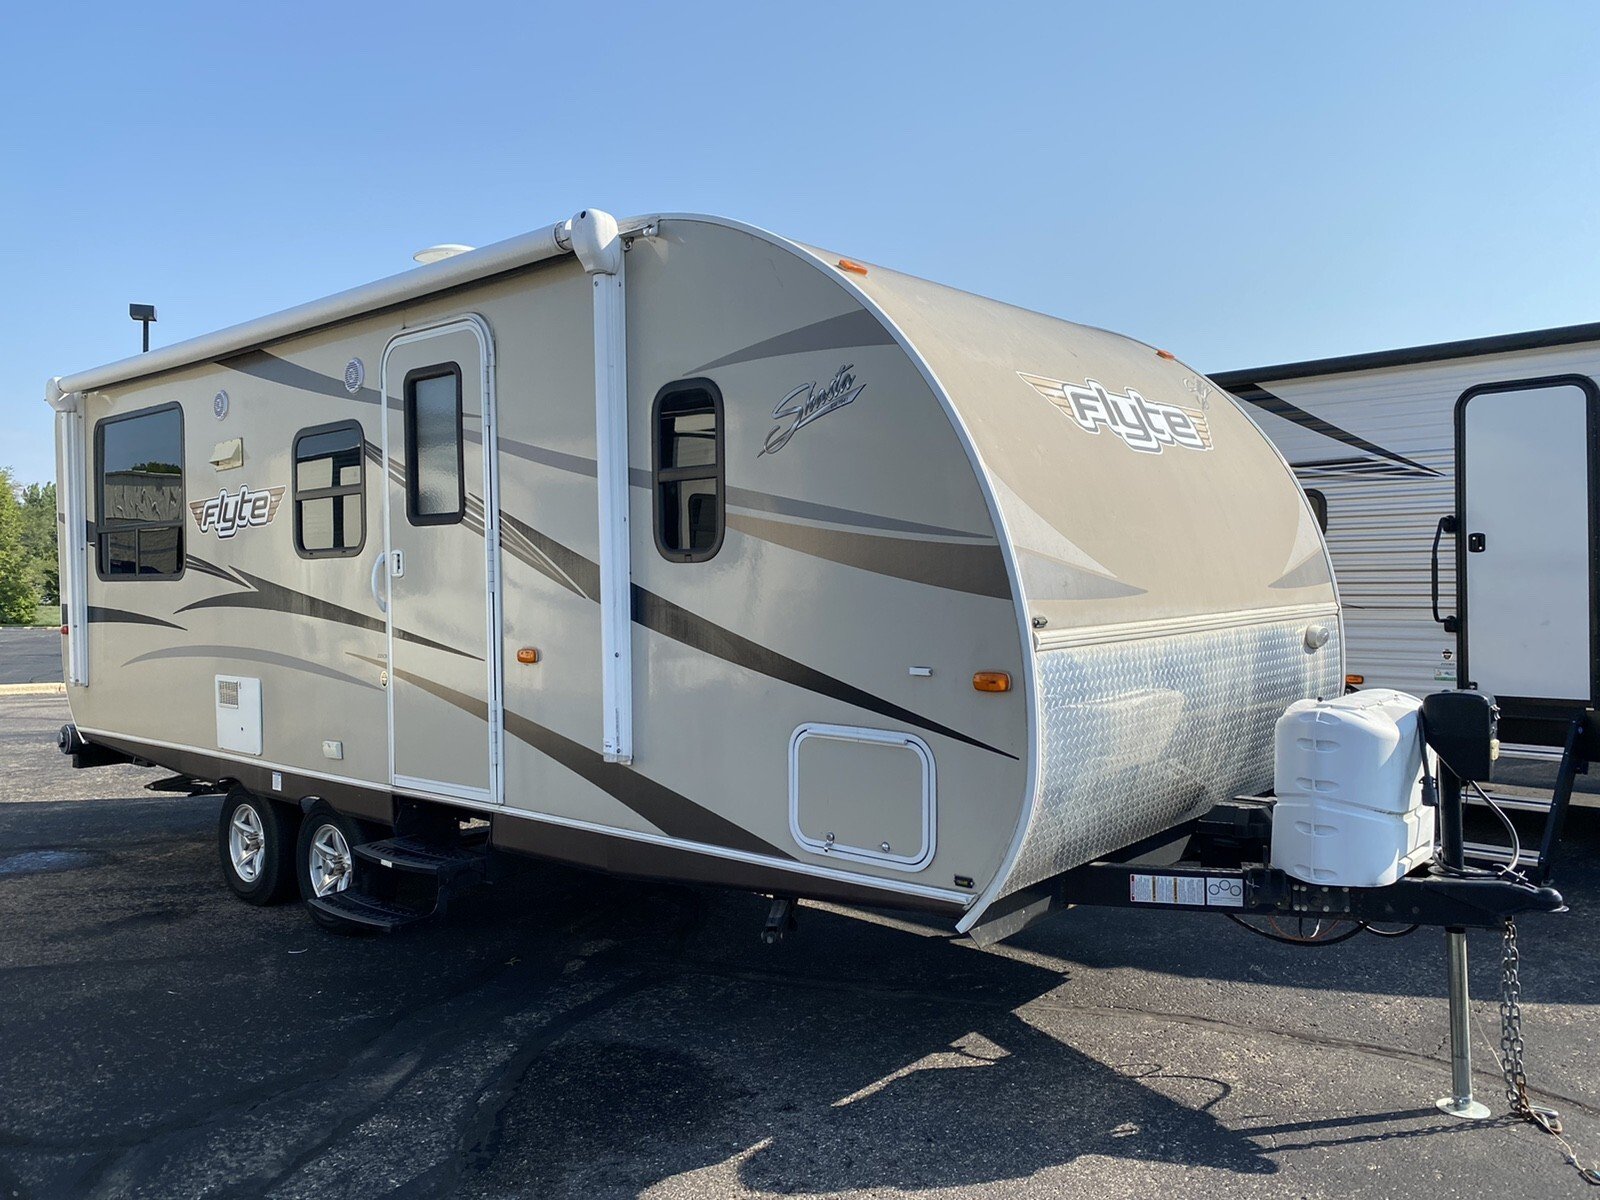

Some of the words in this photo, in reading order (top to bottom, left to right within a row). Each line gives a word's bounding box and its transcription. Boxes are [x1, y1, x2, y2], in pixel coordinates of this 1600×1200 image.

[764, 363, 857, 455] Shasta
[1064, 380, 1206, 451] Flyte
[200, 485, 271, 538] Flyte
